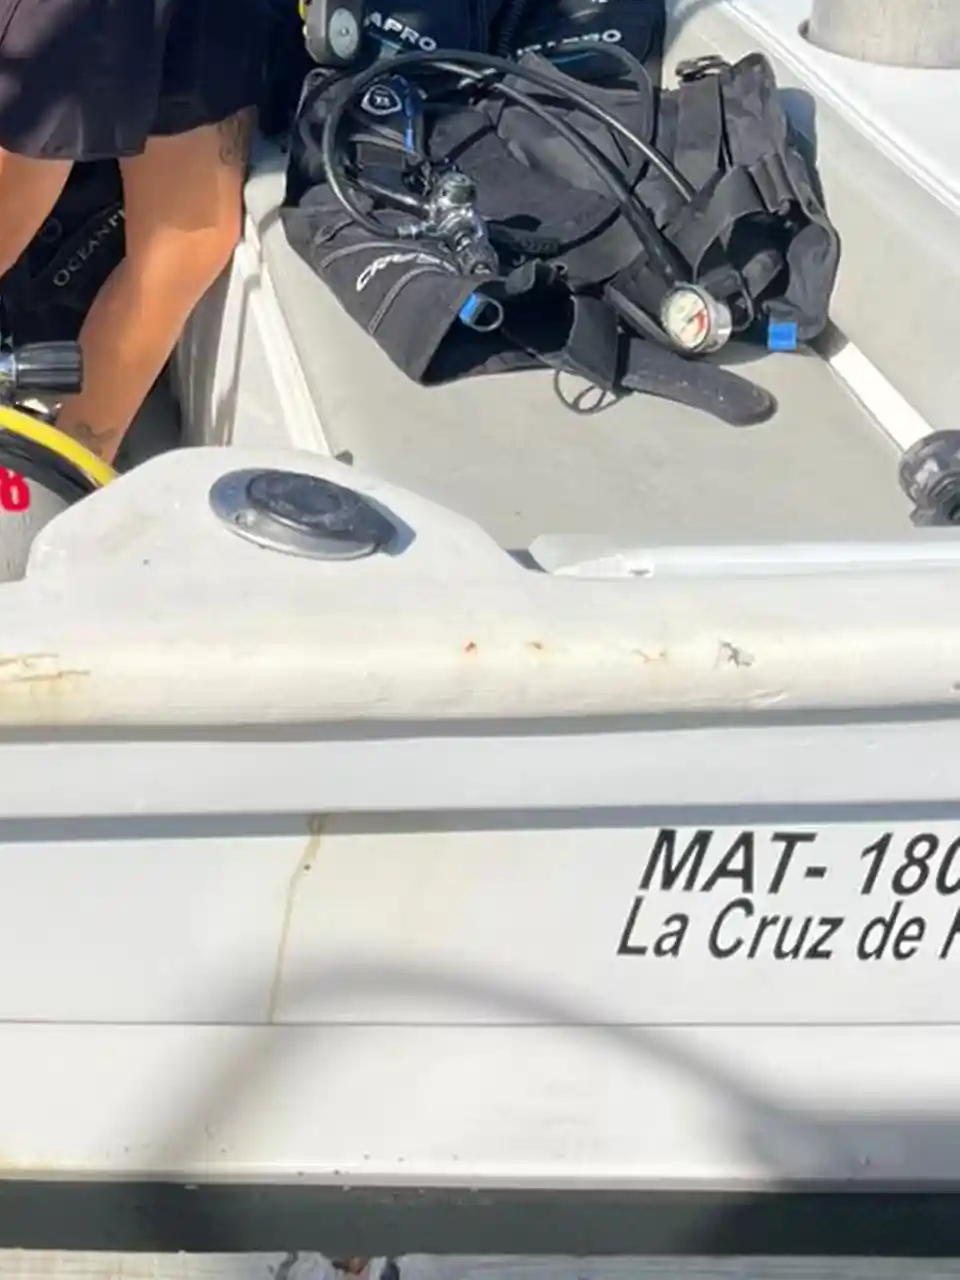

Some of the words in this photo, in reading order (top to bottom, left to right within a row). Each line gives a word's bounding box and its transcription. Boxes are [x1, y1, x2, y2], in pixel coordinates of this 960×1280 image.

[638, 827, 828, 895] MAT-
[616, 895, 690, 959] La
[708, 897, 845, 961] Cruz
[856, 900, 927, 961] de
